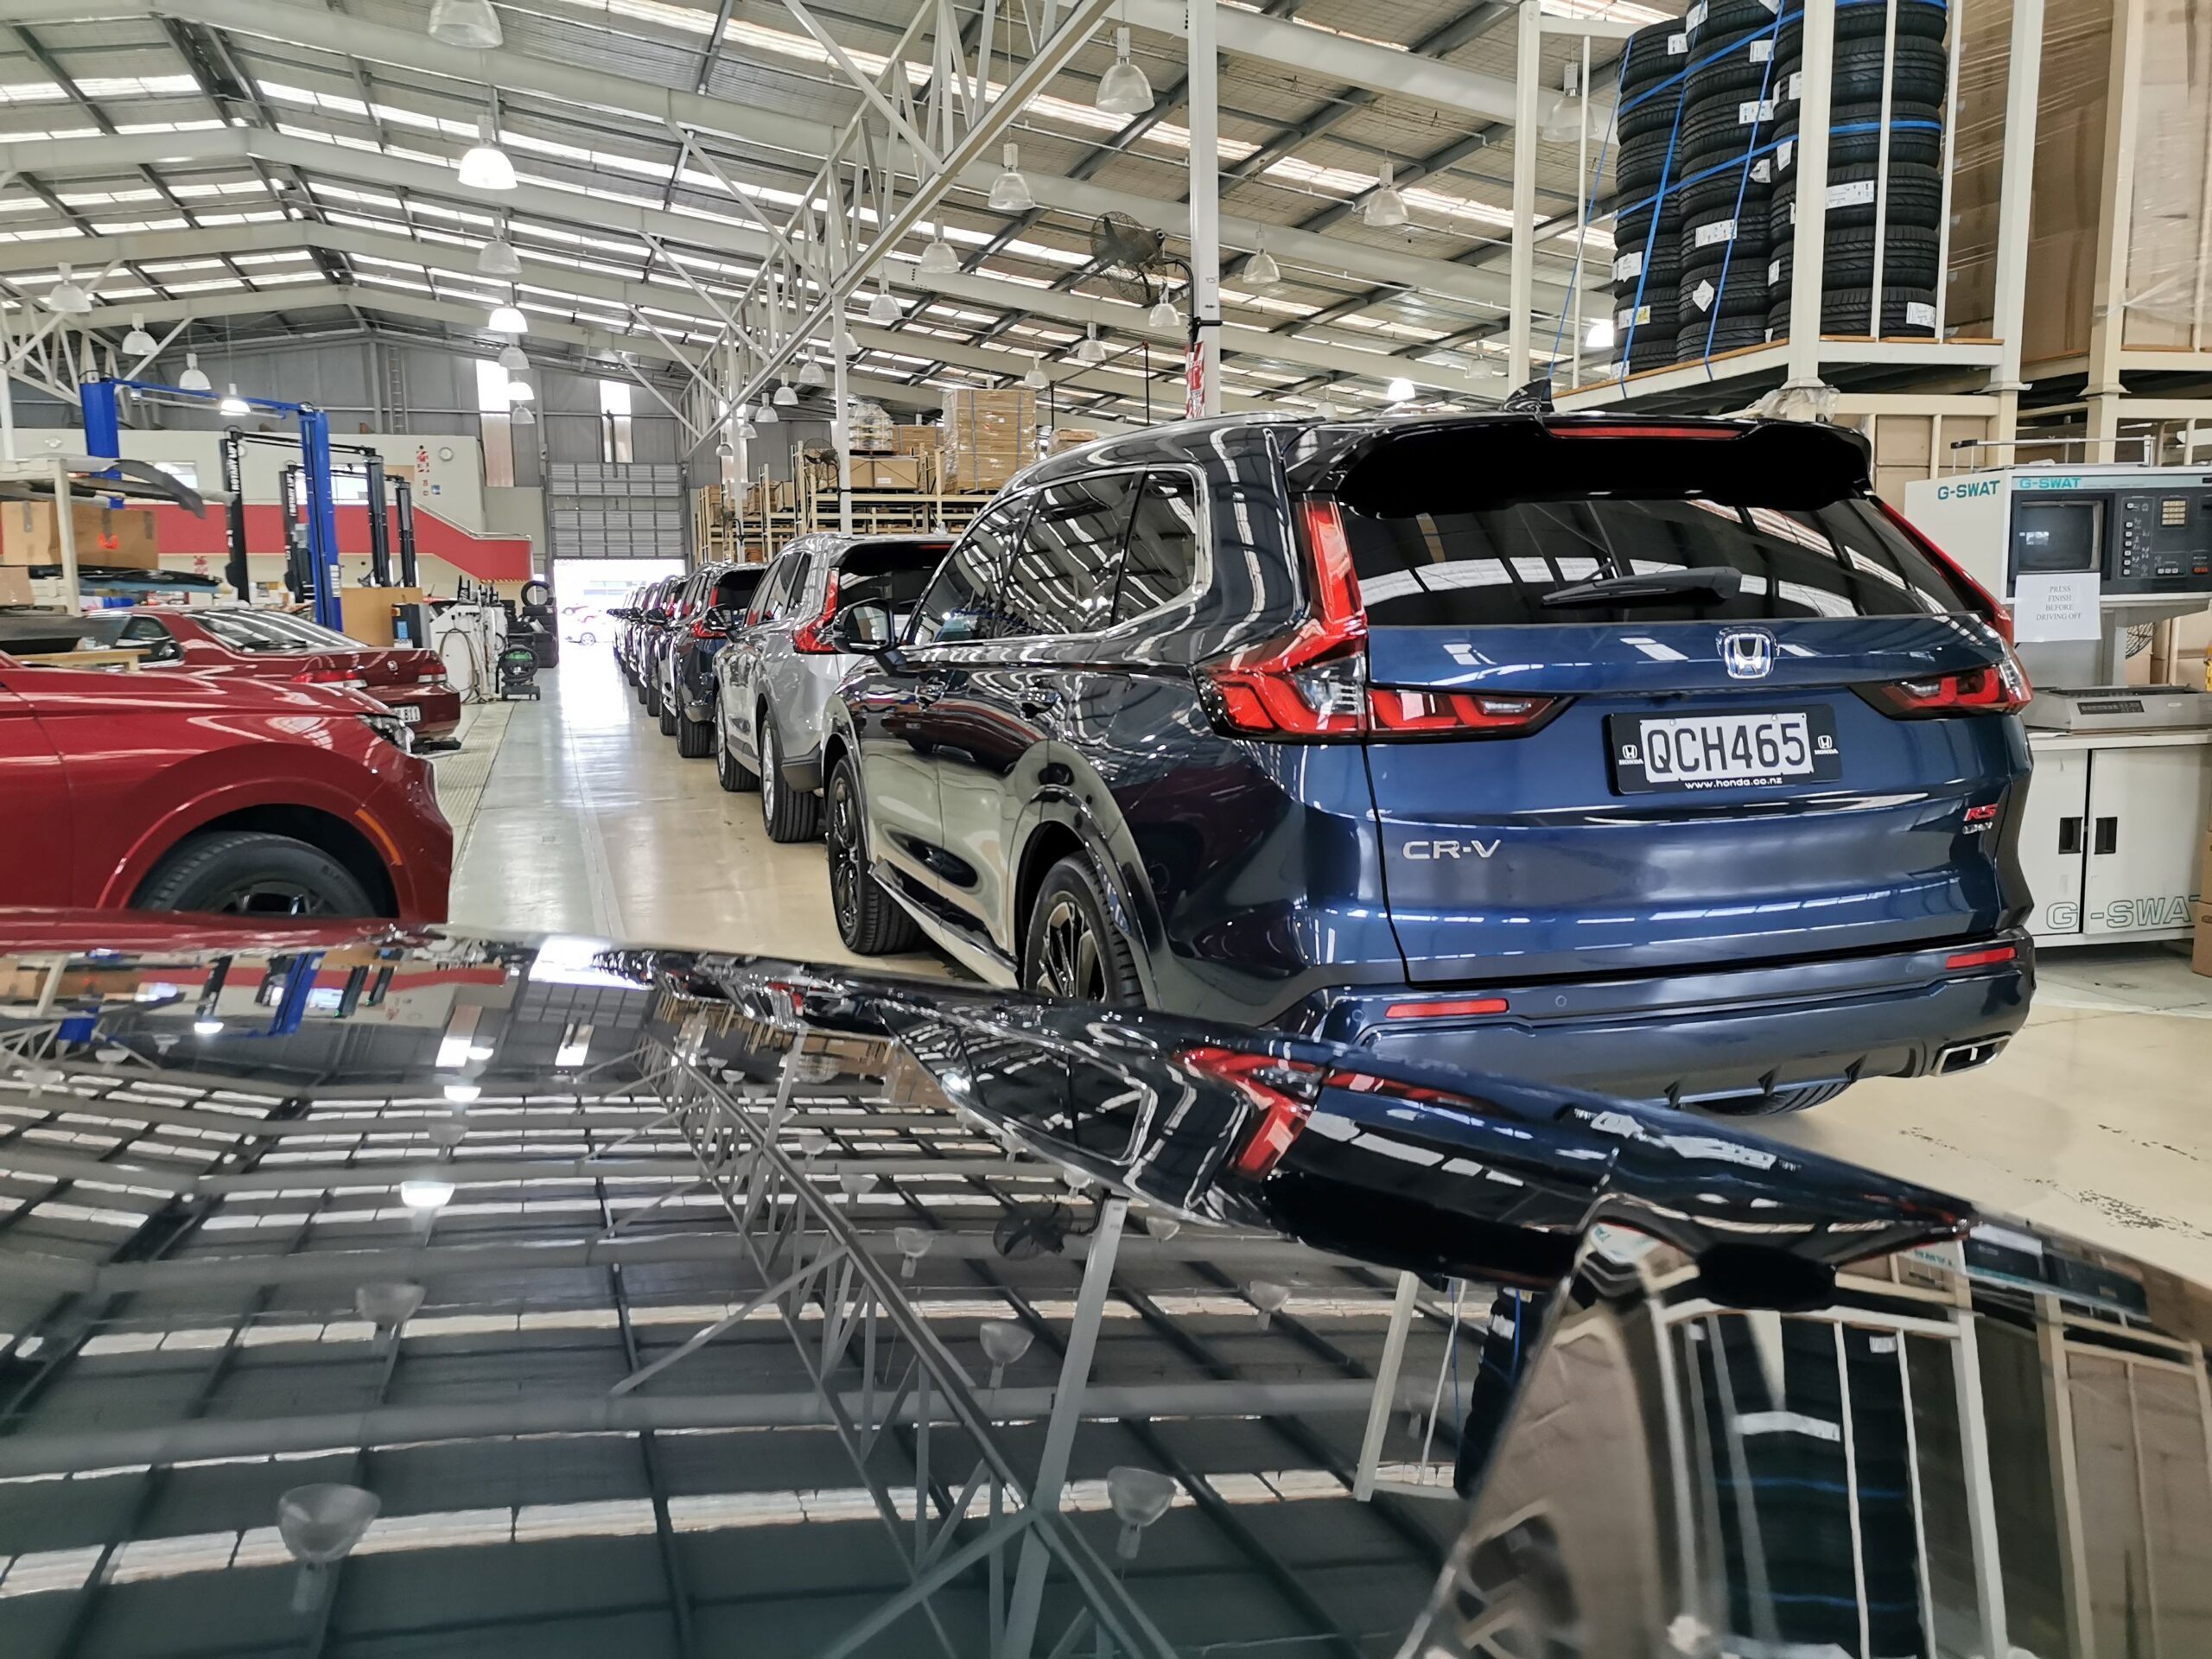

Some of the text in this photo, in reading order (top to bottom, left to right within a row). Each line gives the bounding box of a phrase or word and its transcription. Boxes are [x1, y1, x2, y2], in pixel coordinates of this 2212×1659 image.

[1937, 480, 2000, 500] G-SWAT
[2018, 477, 2082, 489] G-SWAT
[1647, 722, 1806, 774] QCH465
[1685, 777, 1783, 790] www.honda.co.nz
[1963, 804, 1998, 822] RS
[1403, 839, 1501, 860] CR-V
